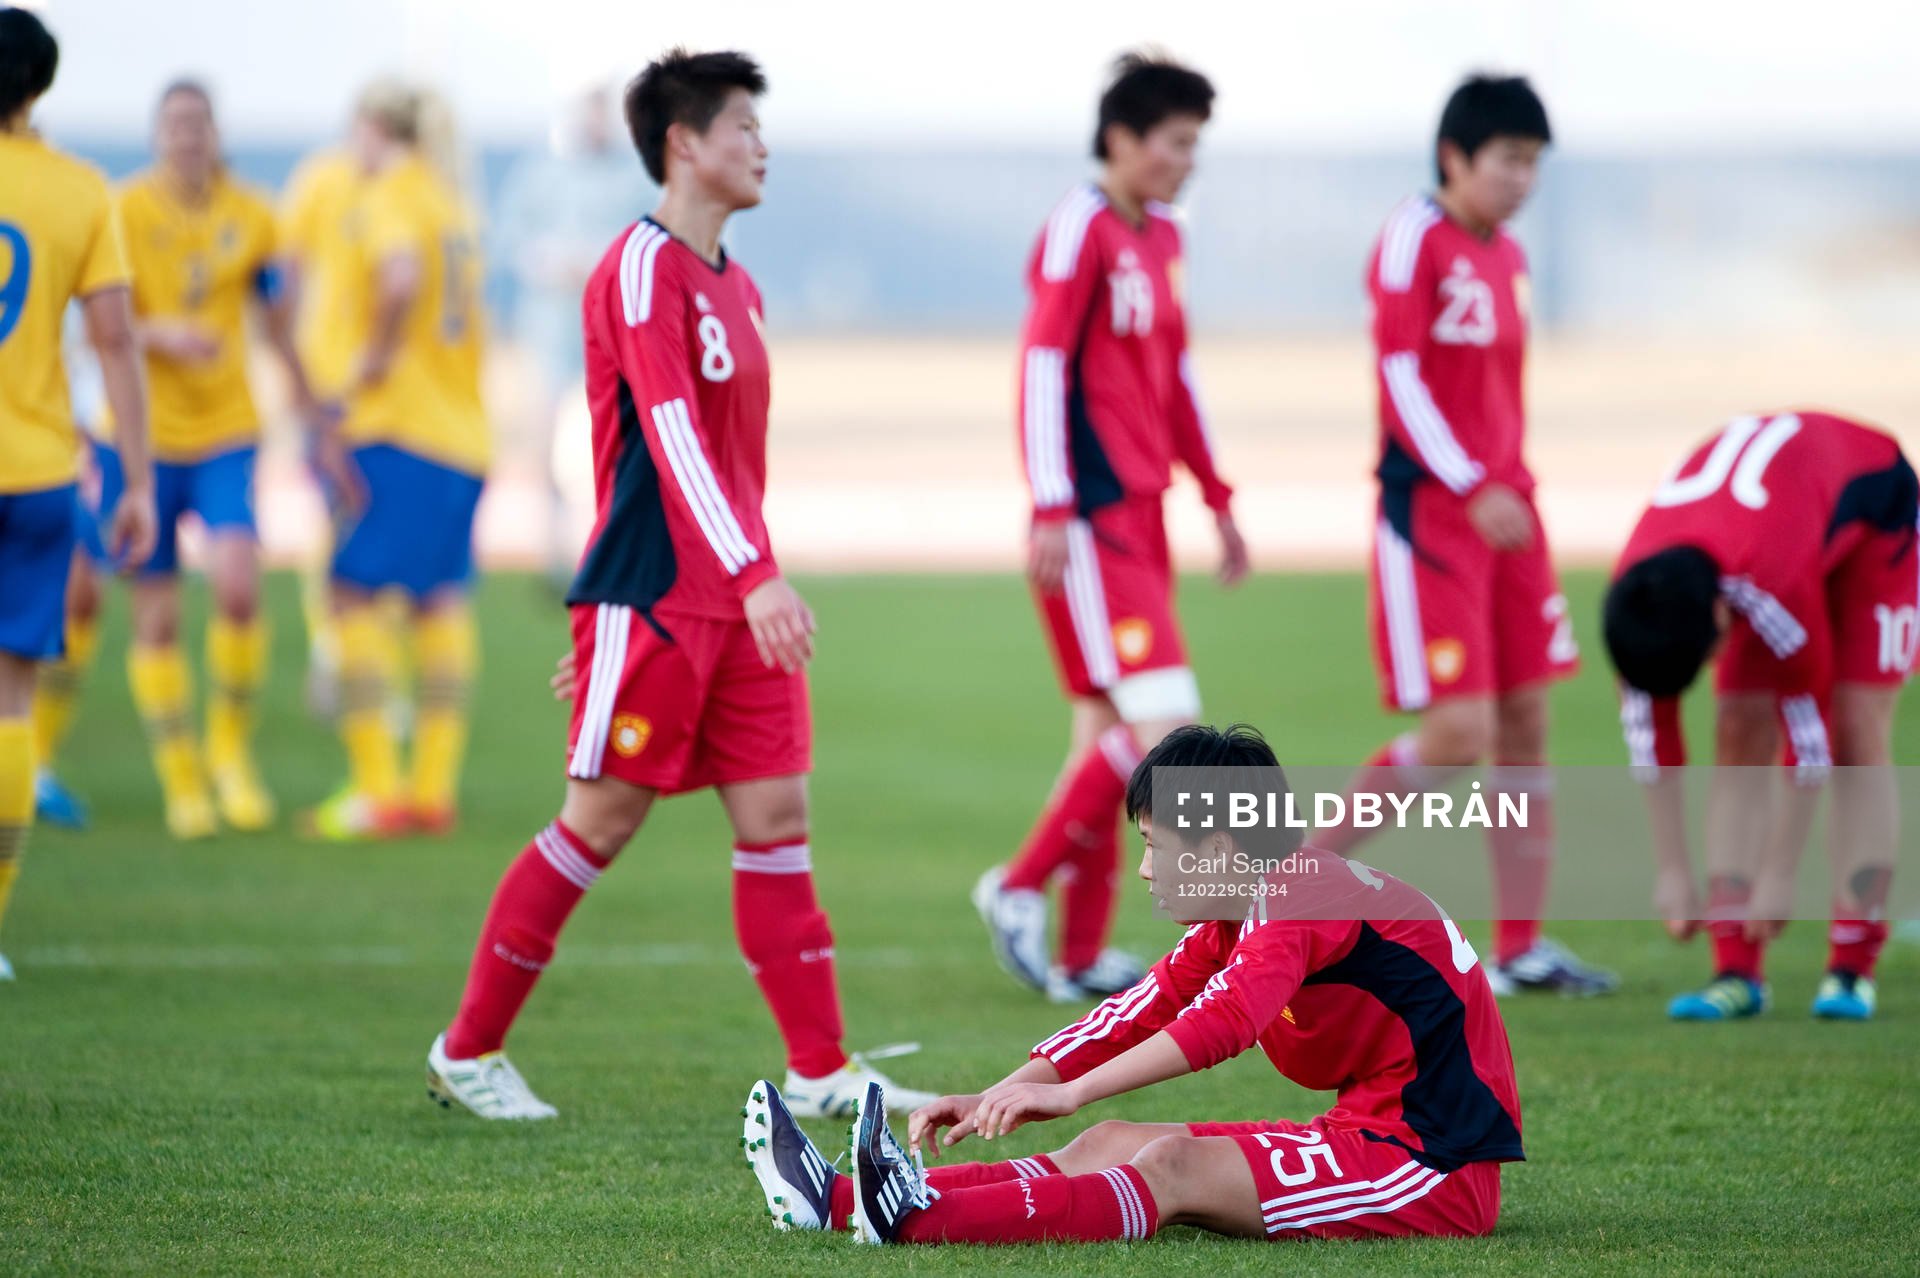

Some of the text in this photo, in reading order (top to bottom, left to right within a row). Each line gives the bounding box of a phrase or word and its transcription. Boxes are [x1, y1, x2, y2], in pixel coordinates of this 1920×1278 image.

[1430, 277, 1498, 346] 23
[698, 314, 735, 382] 8
[1874, 603, 1920, 674] 10
[1251, 1130, 1344, 1187] 25
[1012, 1178, 1037, 1219] HINA
